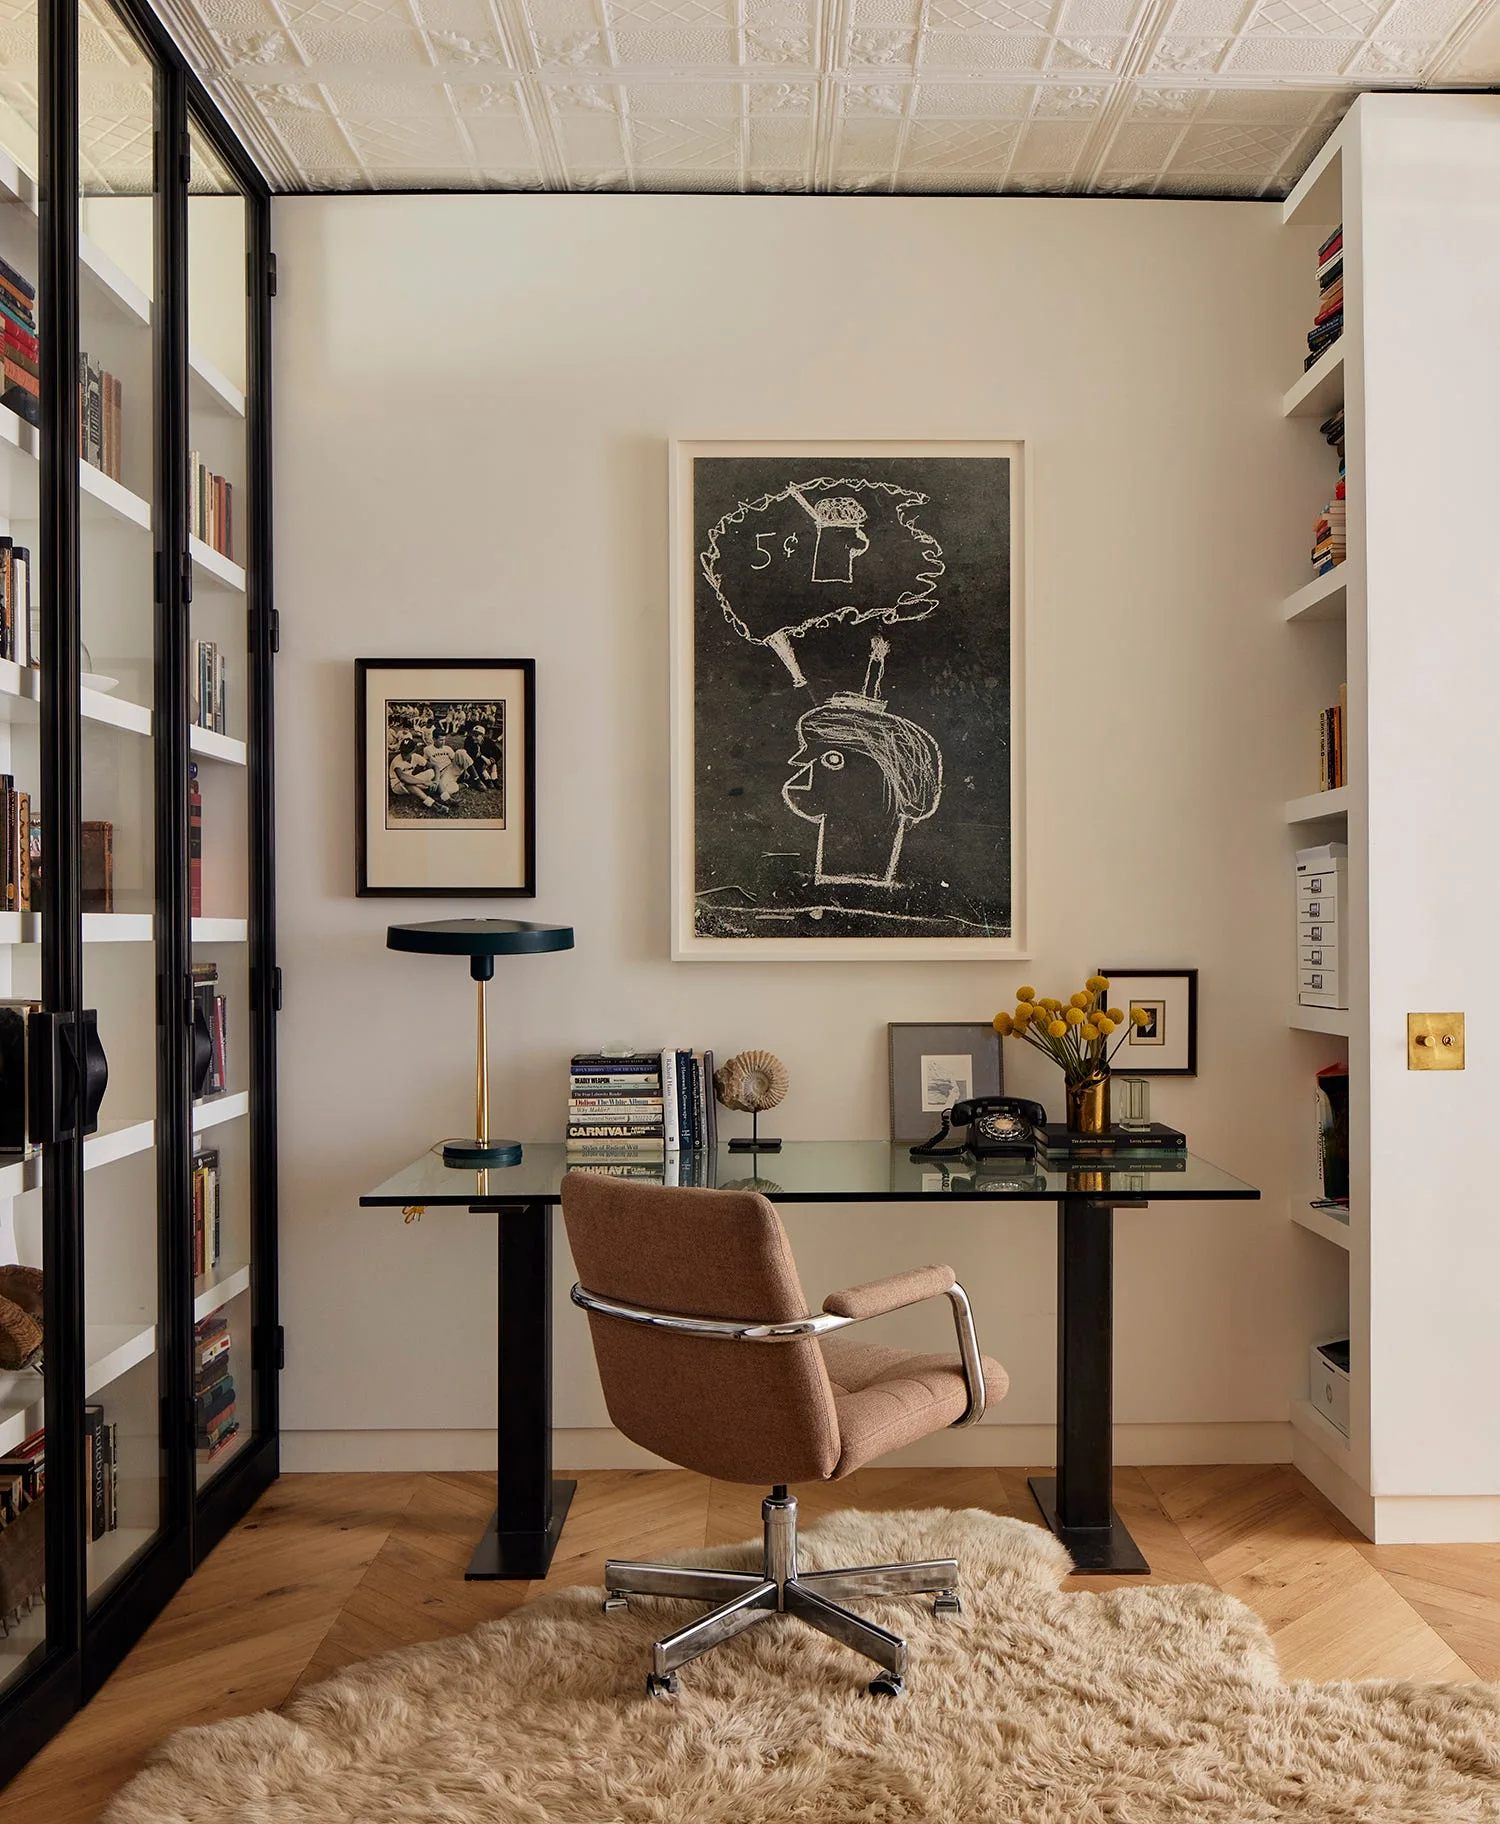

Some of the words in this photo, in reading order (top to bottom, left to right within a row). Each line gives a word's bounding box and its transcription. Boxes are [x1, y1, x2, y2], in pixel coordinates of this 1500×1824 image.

[751, 532, 777, 570] 5
[569, 1127, 631, 1137] CARNIVAL
[95, 1425, 104, 1508] notebooks
